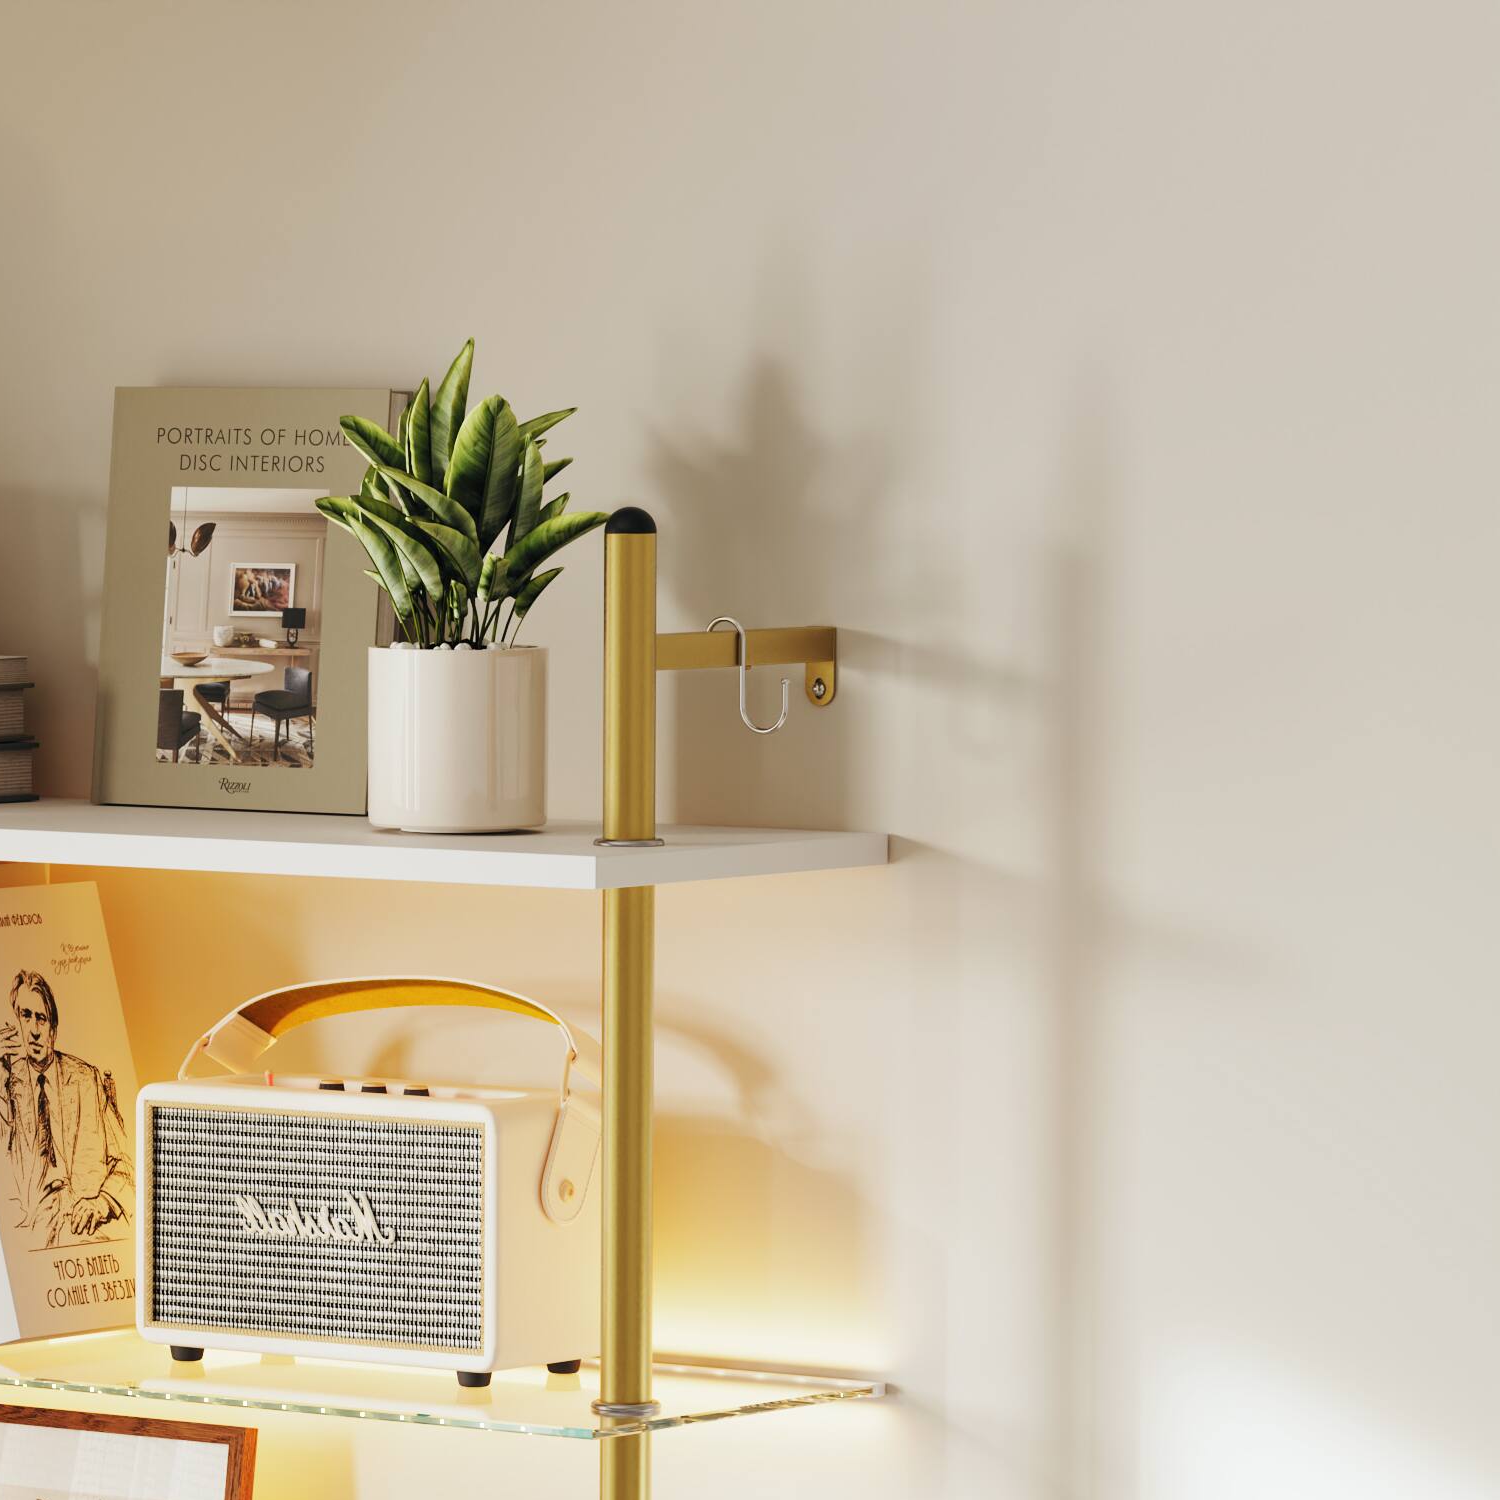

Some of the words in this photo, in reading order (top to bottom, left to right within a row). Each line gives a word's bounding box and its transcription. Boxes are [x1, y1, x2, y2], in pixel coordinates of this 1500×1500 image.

[156, 427, 253, 446] PORTRAITS
[260, 428, 286, 446] OF
[179, 454, 222, 471] DISC
[229, 455, 326, 473] INTERIORS
[218, 777, 252, 794] RIZZOLI
[53, 1258, 85, 1281] ЧТОБ
[86, 1254, 120, 1277] ВИДЕТЬ
[47, 1284, 90, 1308] СОЛНЦЕ
[91, 1283, 100, 1303] И
